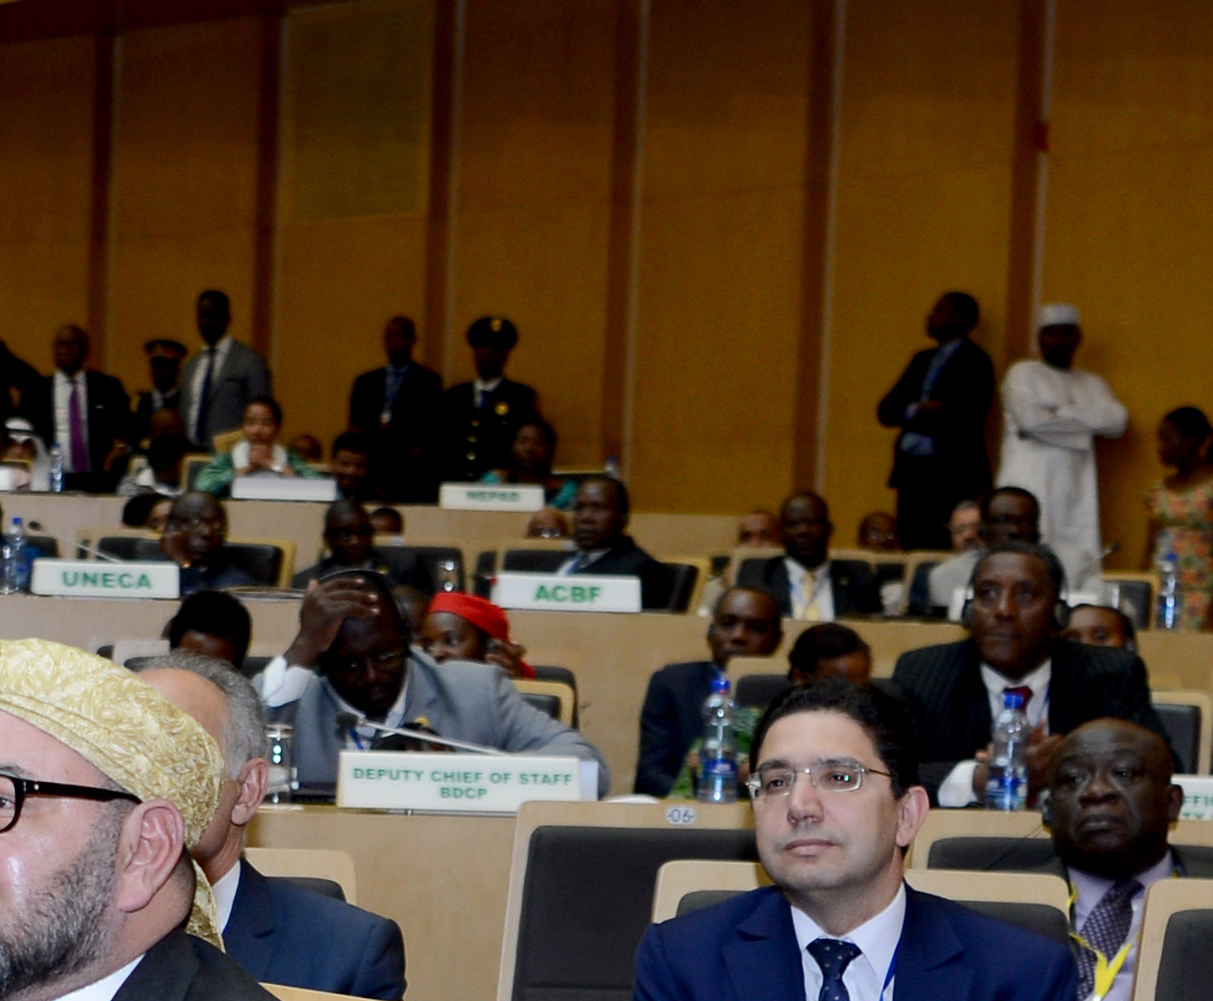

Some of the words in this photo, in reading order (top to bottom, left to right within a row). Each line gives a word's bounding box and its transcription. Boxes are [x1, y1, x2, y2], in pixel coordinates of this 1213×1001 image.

[62, 571, 152, 589] UNECA
[534, 585, 602, 603] ACBF
[353, 767, 424, 782] DEPUTY
[431, 770, 483, 784] CHIEF
[490, 772, 512, 784] OF
[519, 773, 572, 786] STAFF
[440, 786, 488, 799] BDCP
[670, 808, 692, 823] 06
